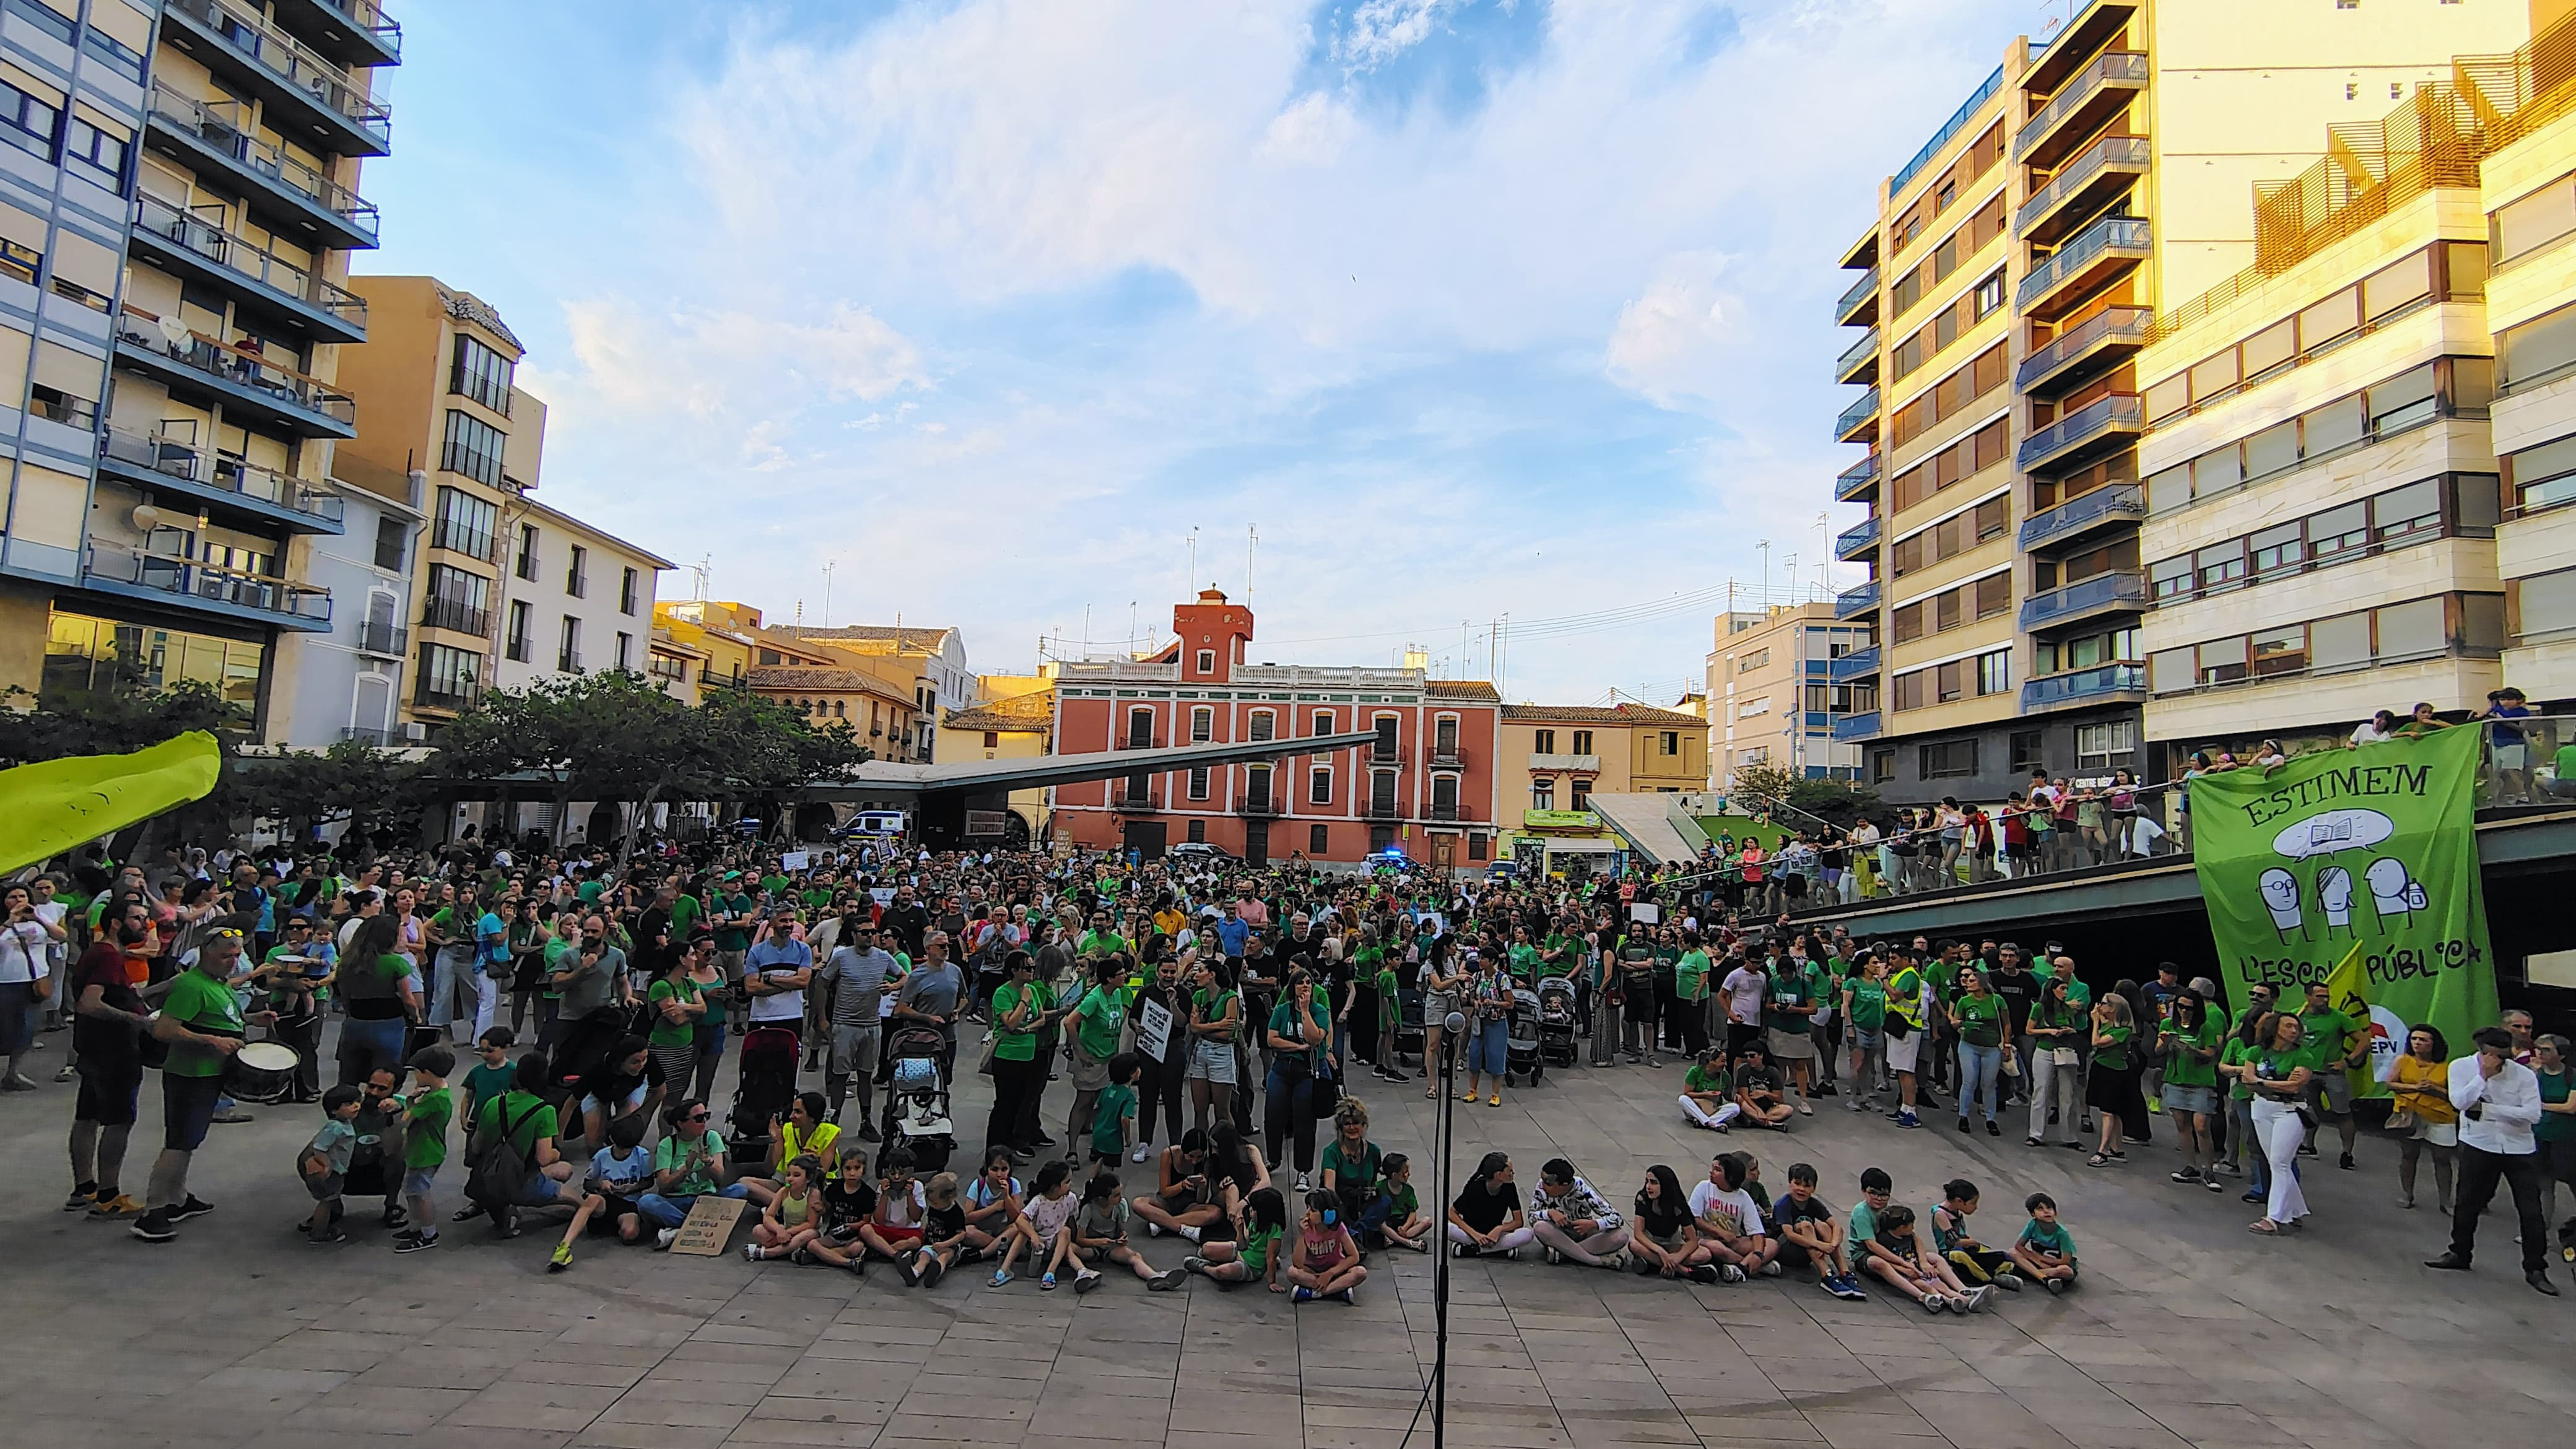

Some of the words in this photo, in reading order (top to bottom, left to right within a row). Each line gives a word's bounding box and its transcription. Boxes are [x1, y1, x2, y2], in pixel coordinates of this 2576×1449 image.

[2076, 778, 2097, 788] CENTRE
[2242, 764, 2433, 827] ESTIMEM
[2240, 955, 2334, 987] L'ESCOL
[2370, 1041, 2398, 1054] EPV
